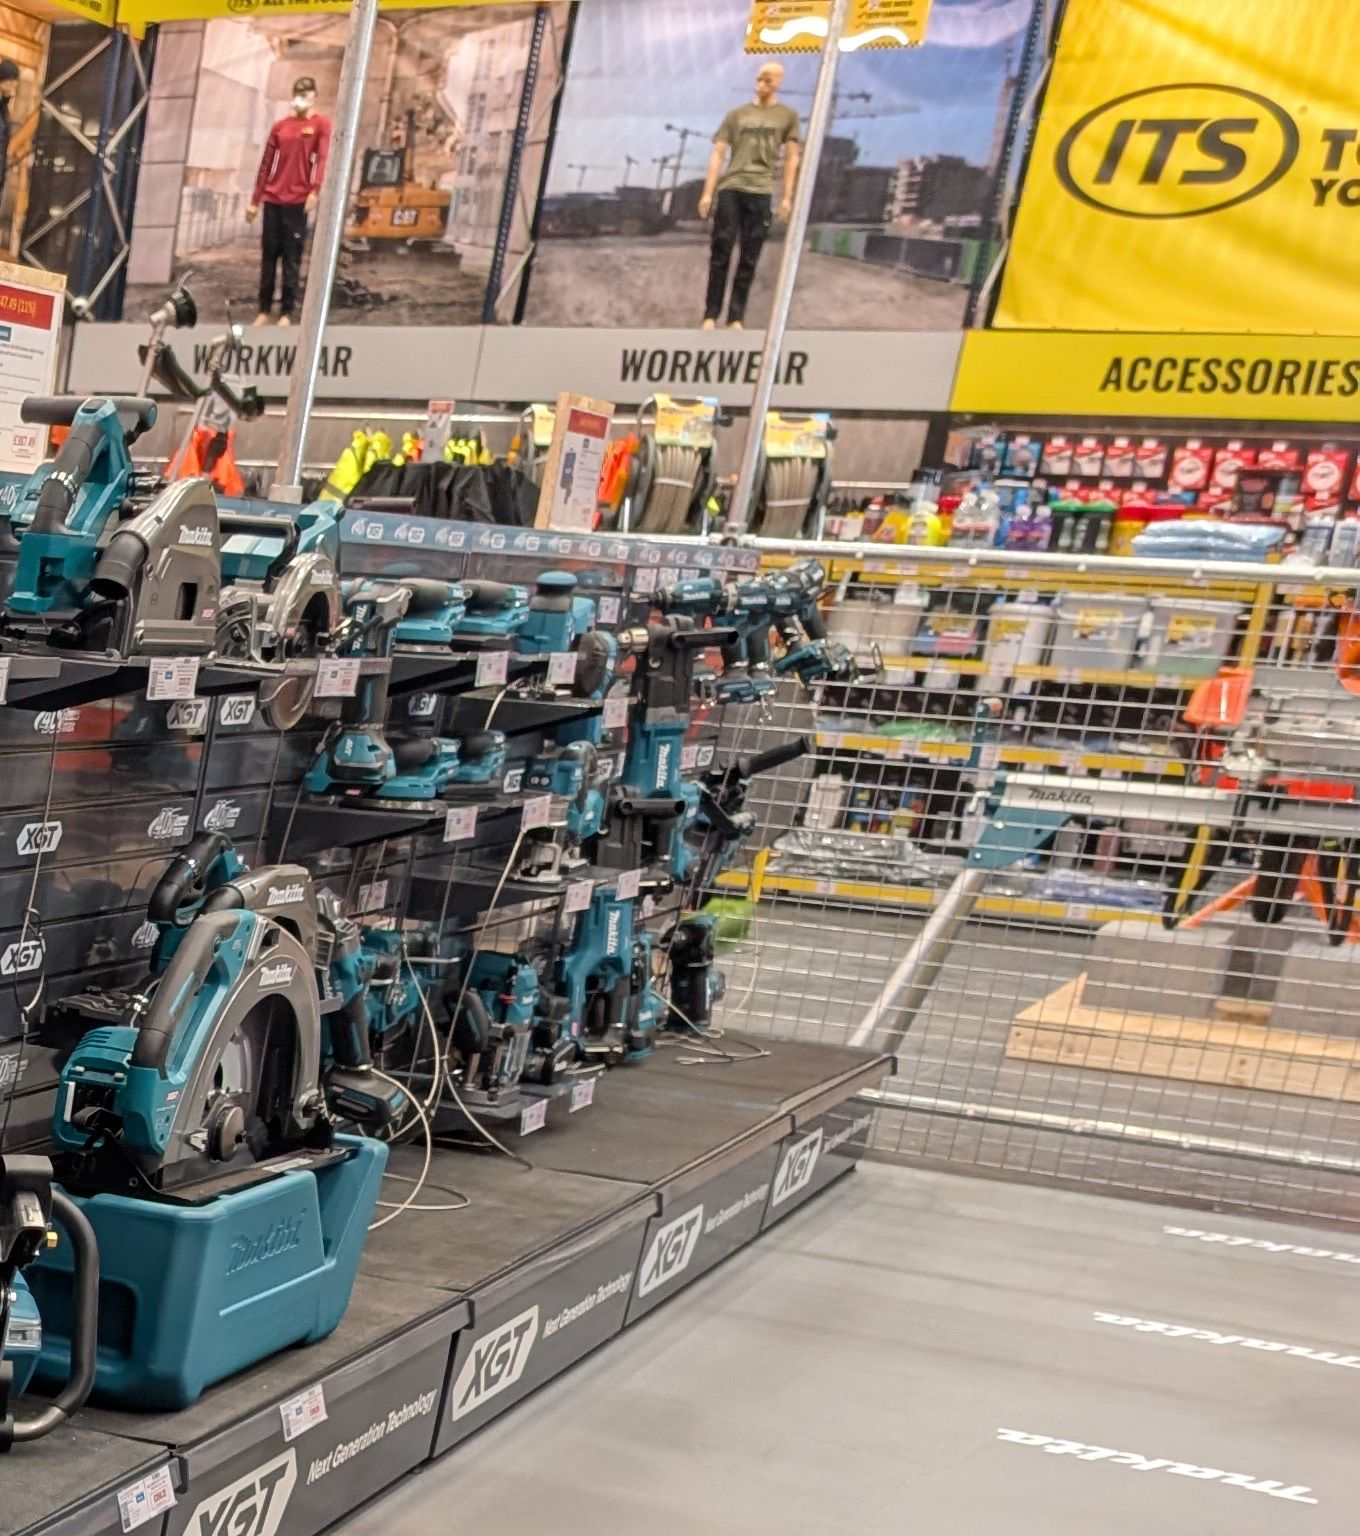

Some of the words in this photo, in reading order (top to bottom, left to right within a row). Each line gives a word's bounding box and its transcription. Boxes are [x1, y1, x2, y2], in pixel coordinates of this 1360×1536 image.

[1093, 118, 1259, 186] ITS
[193, 343, 353, 378] WORKWAR
[1099, 356, 1360, 397] ACCESSORIES
[21, 825, 59, 850] XGT
[455, 1319, 535, 1416] XGT
[307, 1454, 333, 1485] Next
[334, 1418, 385, 1477] Generation
[386, 1388, 438, 1440] Technology
[996, 1427, 1319, 1505] Makita
